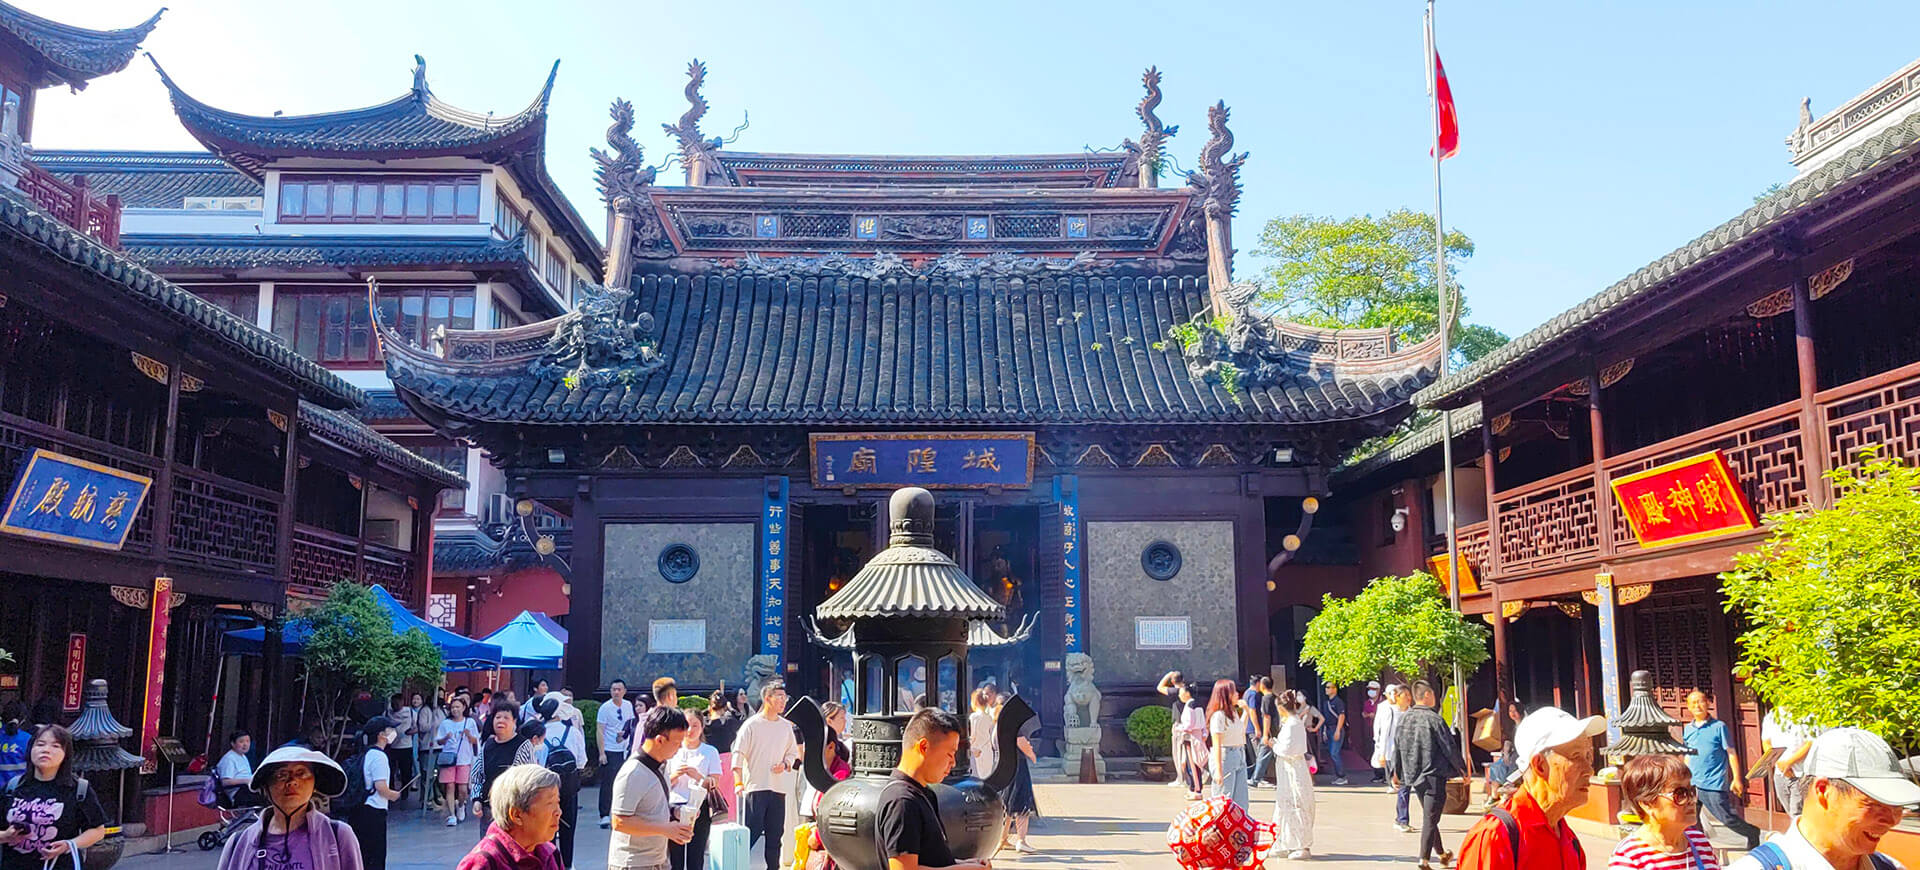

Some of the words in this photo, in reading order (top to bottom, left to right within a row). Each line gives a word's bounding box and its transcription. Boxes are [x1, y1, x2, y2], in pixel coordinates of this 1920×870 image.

[846, 446, 1001, 475] 城隍廟
[27, 476, 131, 531] 慈航殿
[1637, 472, 1728, 526] 財神殿
